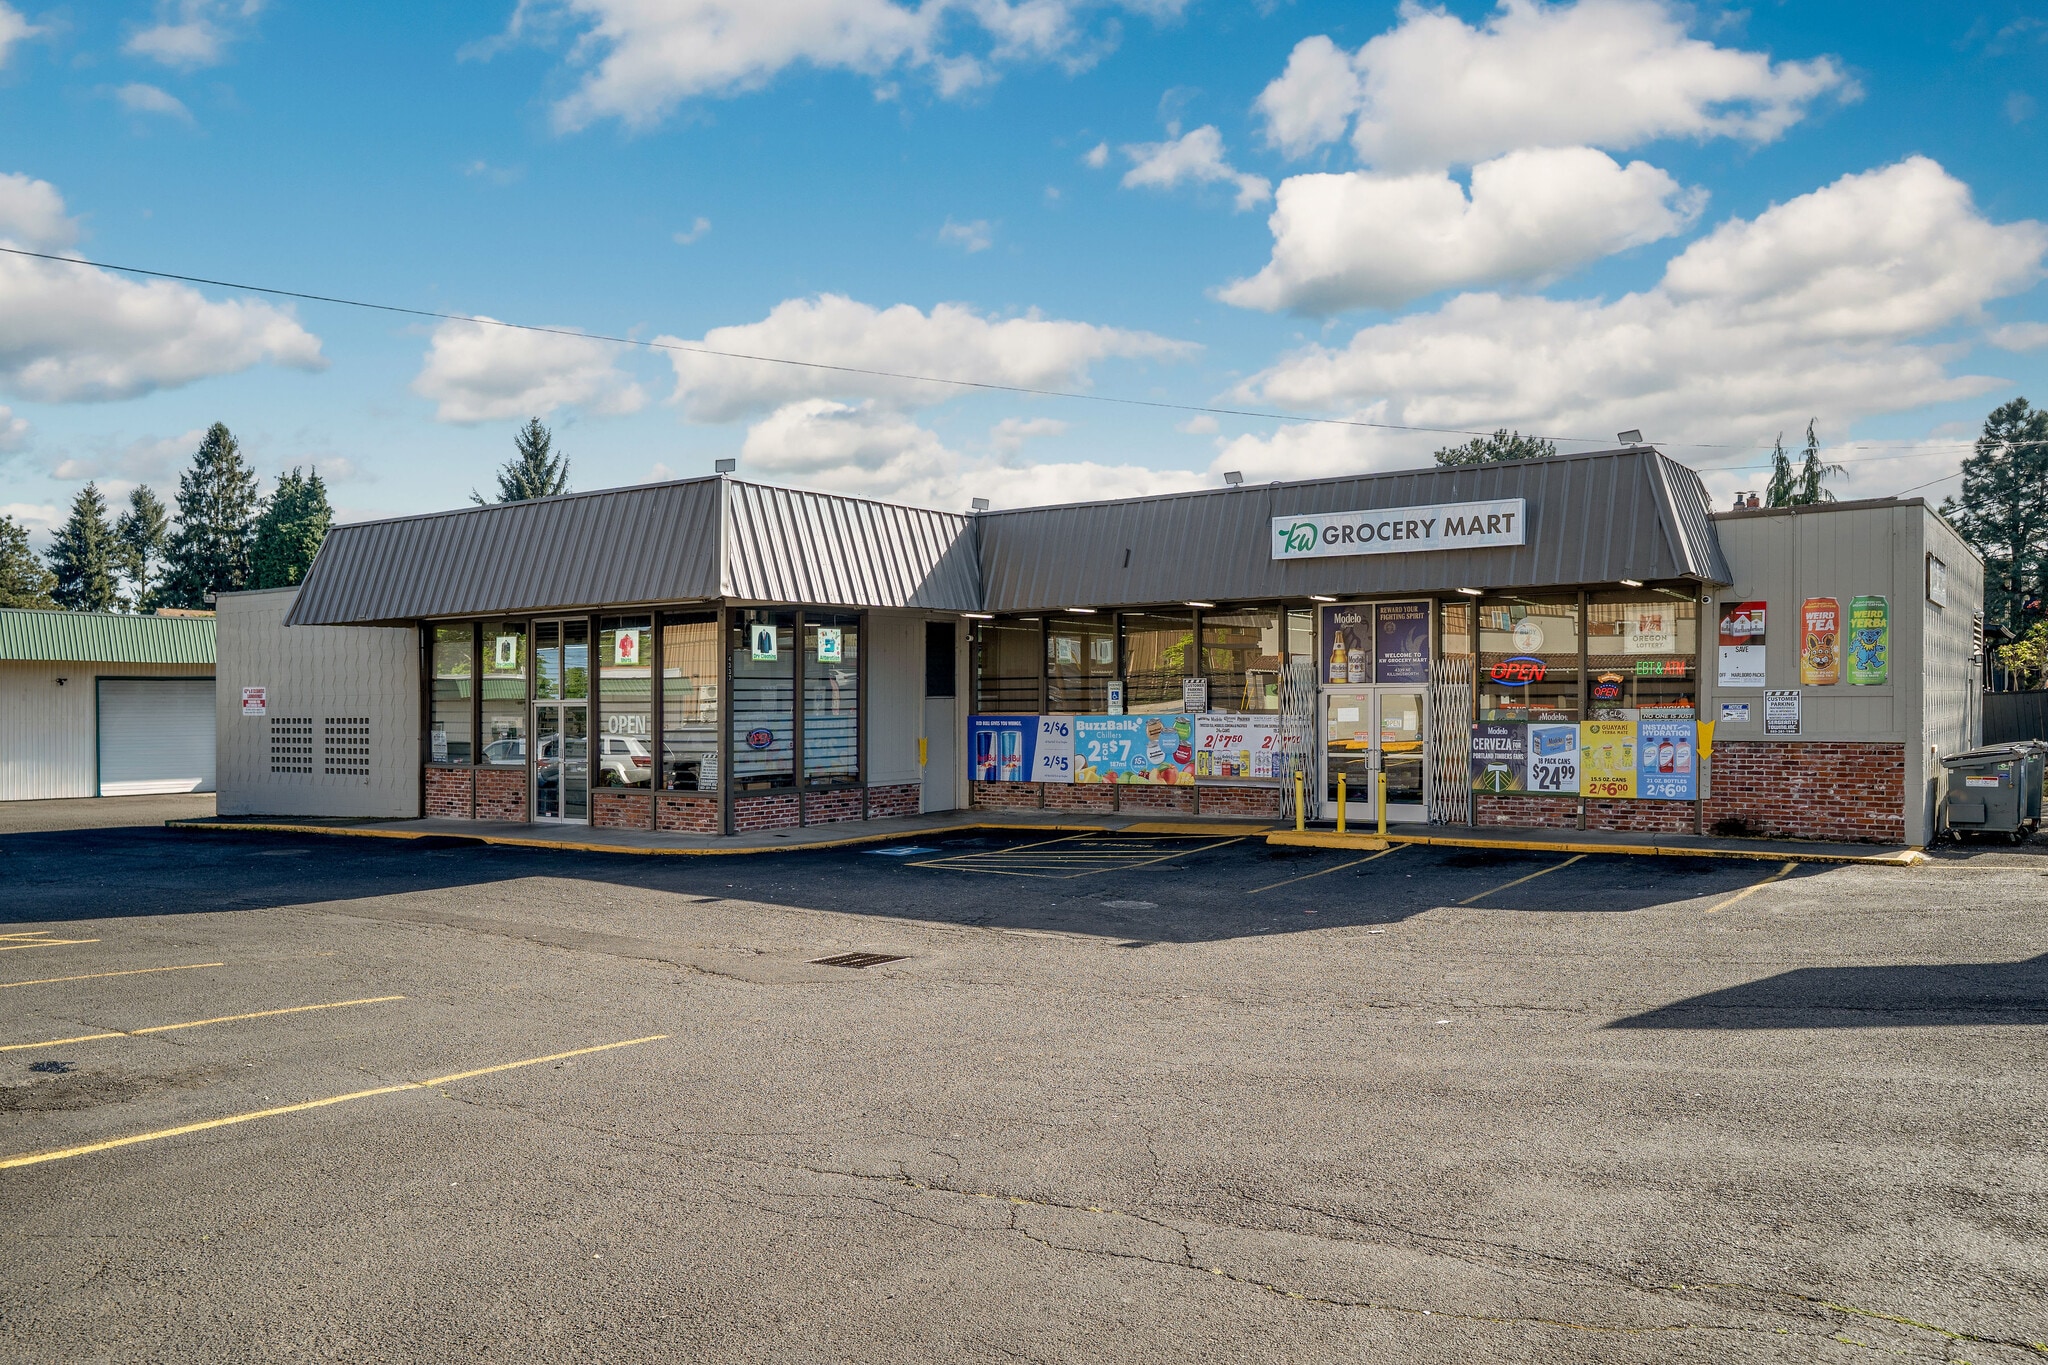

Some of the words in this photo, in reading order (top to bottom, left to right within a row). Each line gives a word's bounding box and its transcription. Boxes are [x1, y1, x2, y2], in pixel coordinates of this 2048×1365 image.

[1322, 518, 1436, 544] GROCERY
[1444, 513, 1515, 536] MART
[1334, 613, 1362, 624] Modelo
[1806, 620, 1834, 631] TEA
[1851, 618, 1887, 628] YERBA
[1490, 662, 1547, 681] OPEN
[1636, 662, 1655, 674] EBT
[1656, 662, 1663, 674] &
[1664, 661, 1685, 675] ATM
[1594, 688, 1618, 696] OPEN
[608, 716, 646, 734] OPEN
[1044, 722, 1069, 736] 2/$6
[1088, 740, 1101, 762] 2
[1109, 739, 1132, 762] $7
[1473, 738, 1512, 750] CERVEZA
[1044, 756, 1068, 771] 2/$5
